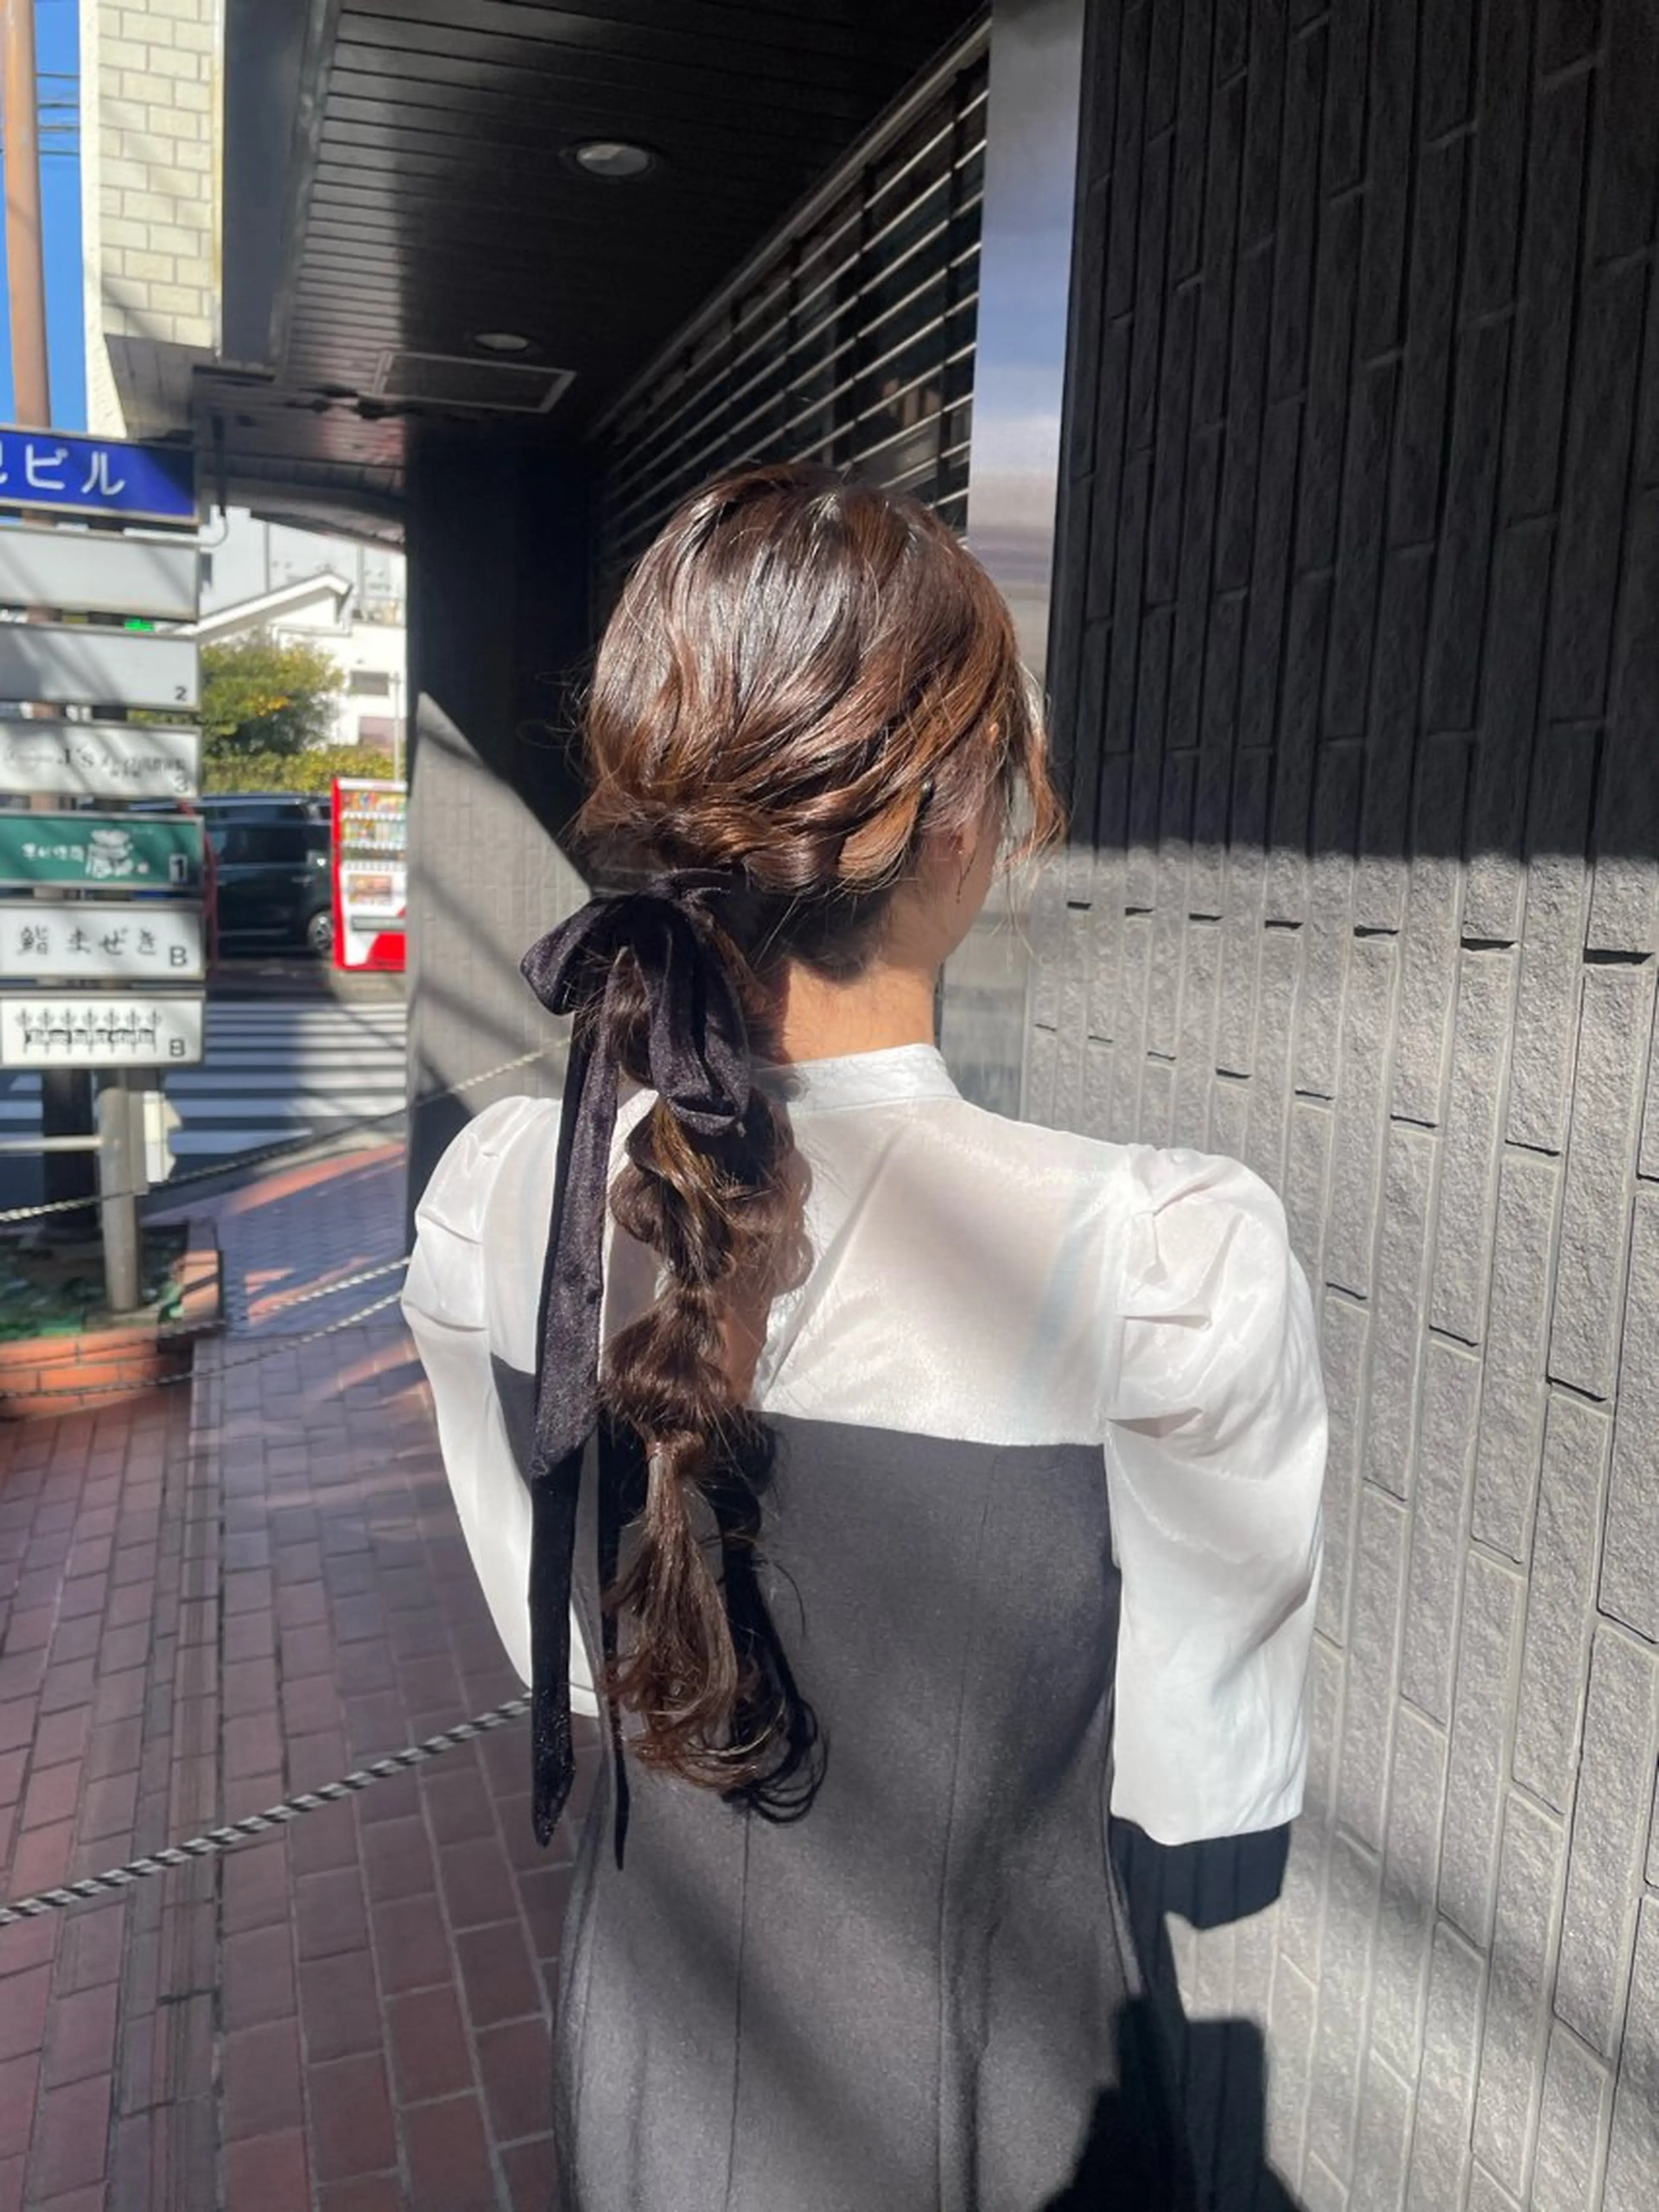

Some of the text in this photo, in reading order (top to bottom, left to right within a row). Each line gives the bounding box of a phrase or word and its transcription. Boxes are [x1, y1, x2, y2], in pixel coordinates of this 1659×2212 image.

[0, 441, 125, 494] ビル
[175, 686, 187, 702] 2
[175, 859, 184, 878] 1
[171, 946, 187, 966] B
